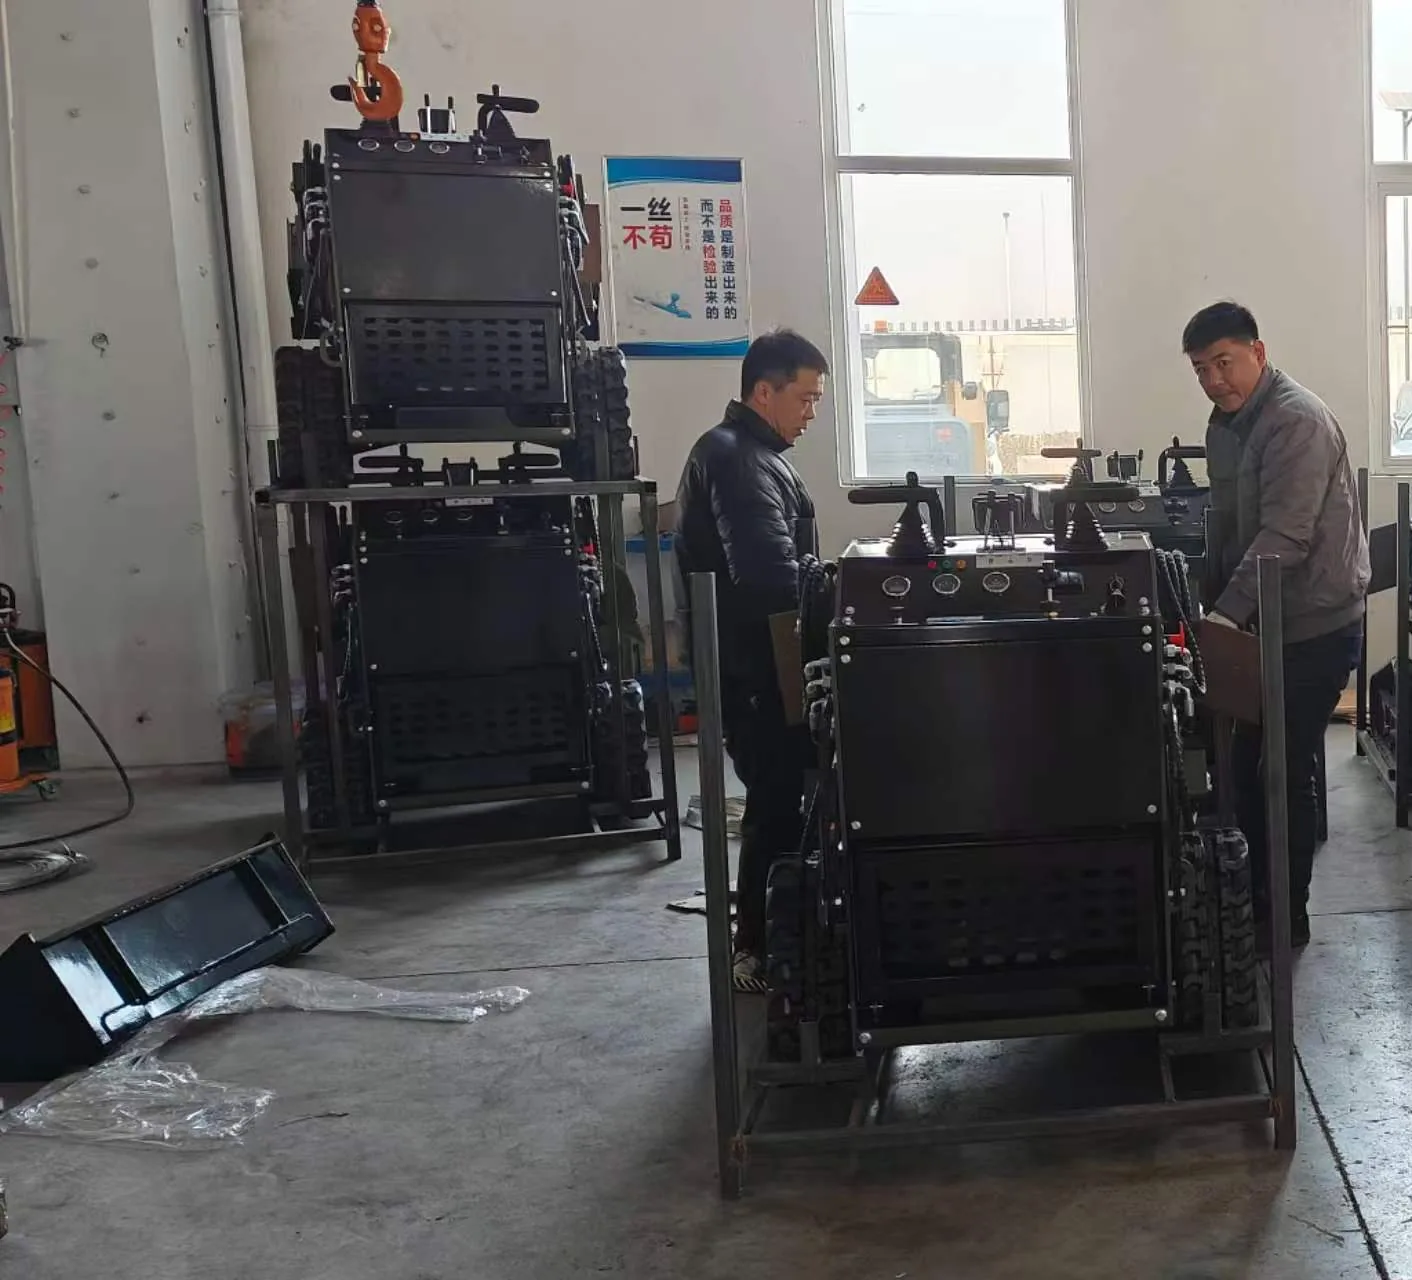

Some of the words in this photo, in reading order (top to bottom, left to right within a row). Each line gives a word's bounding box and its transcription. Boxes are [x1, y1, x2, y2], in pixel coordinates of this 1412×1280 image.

[620, 197, 673, 221] 一丝
[622, 224, 673, 250] 不苟
[700, 199, 719, 319] 而不是检验出来的
[719, 199, 737, 319] 品质是制造出来的
